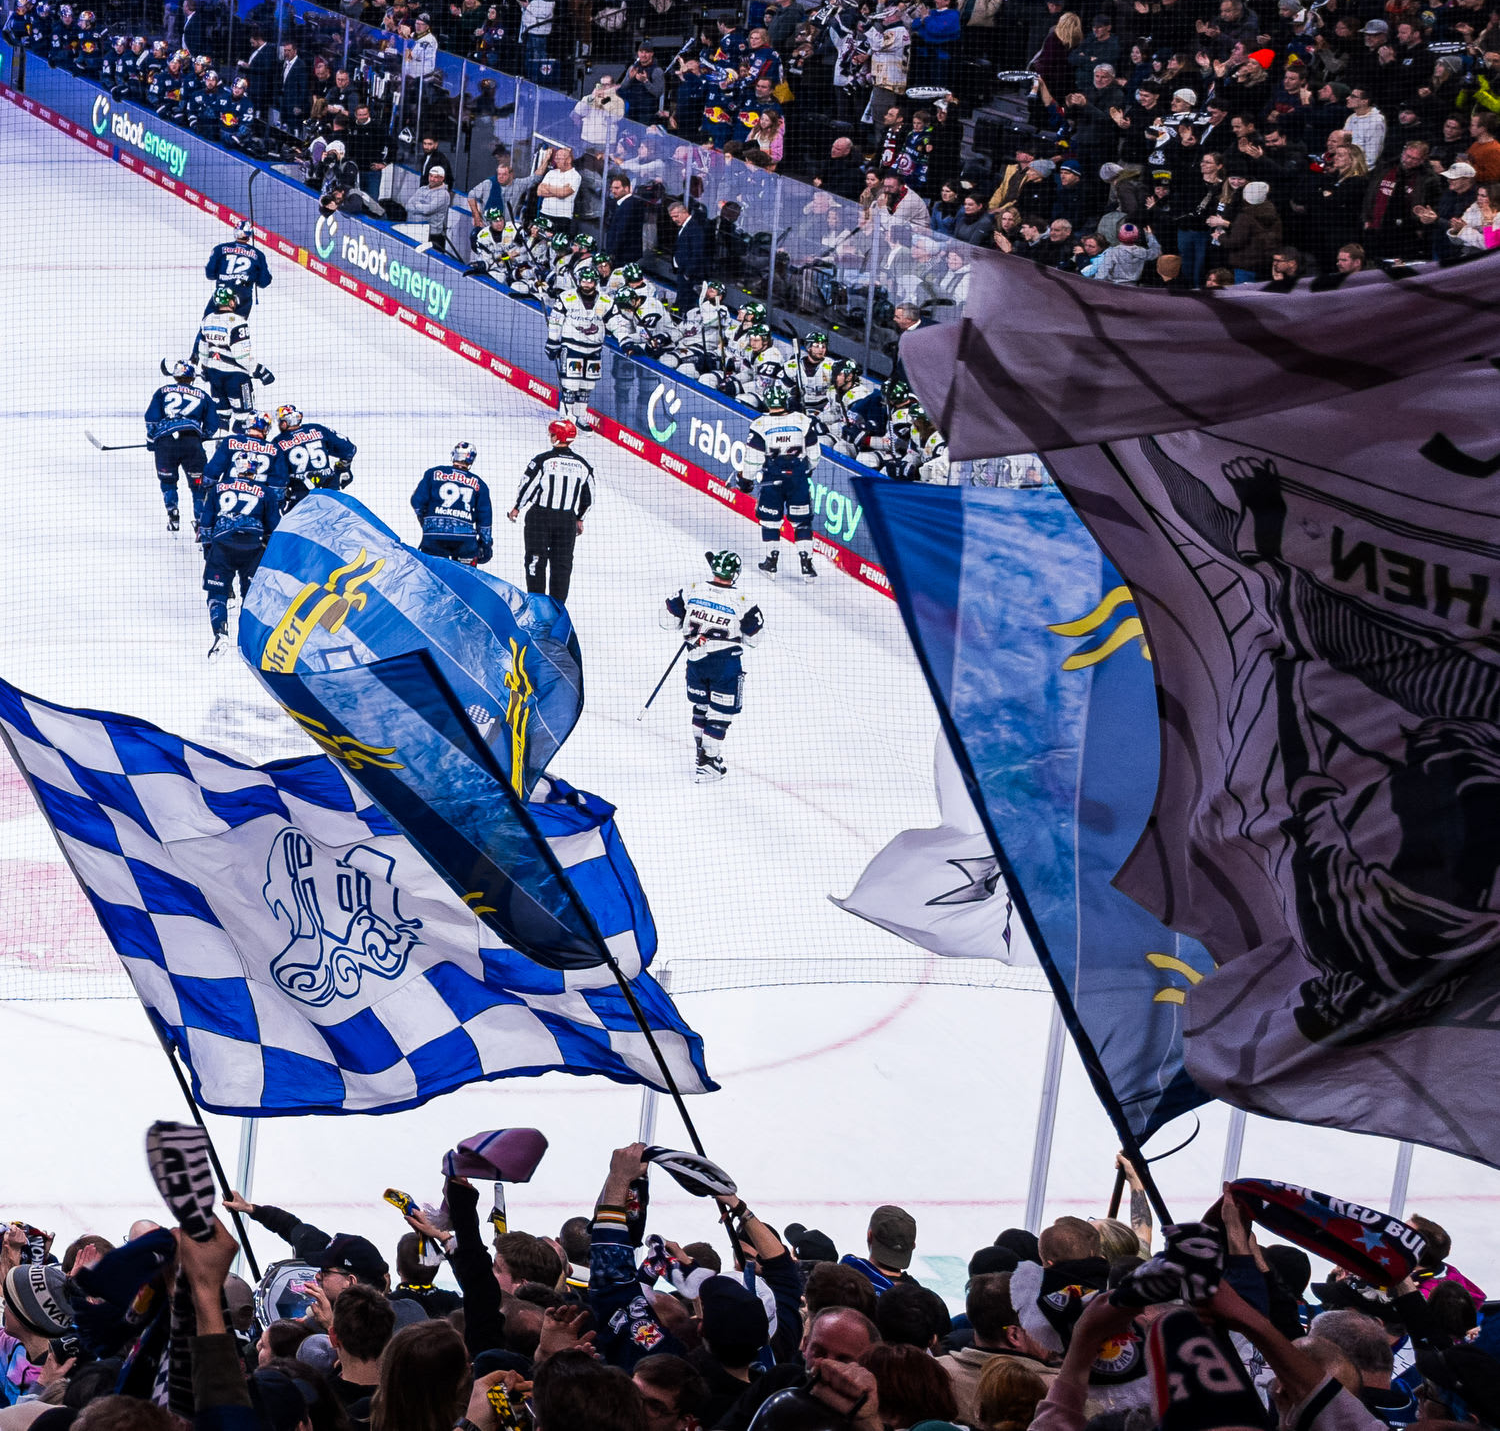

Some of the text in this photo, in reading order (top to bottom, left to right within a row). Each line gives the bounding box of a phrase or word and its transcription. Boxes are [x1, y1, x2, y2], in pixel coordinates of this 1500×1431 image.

[111, 112, 188, 177] rabot.energy
[226, 254, 251, 274] 12
[341, 234, 453, 321] rabot.energy
[164, 392, 202, 418] 27
[775, 435, 791, 445] MIK
[288, 441, 328, 474] 95
[217, 490, 259, 517] 97
[690, 609, 731, 627] MÜLLER
